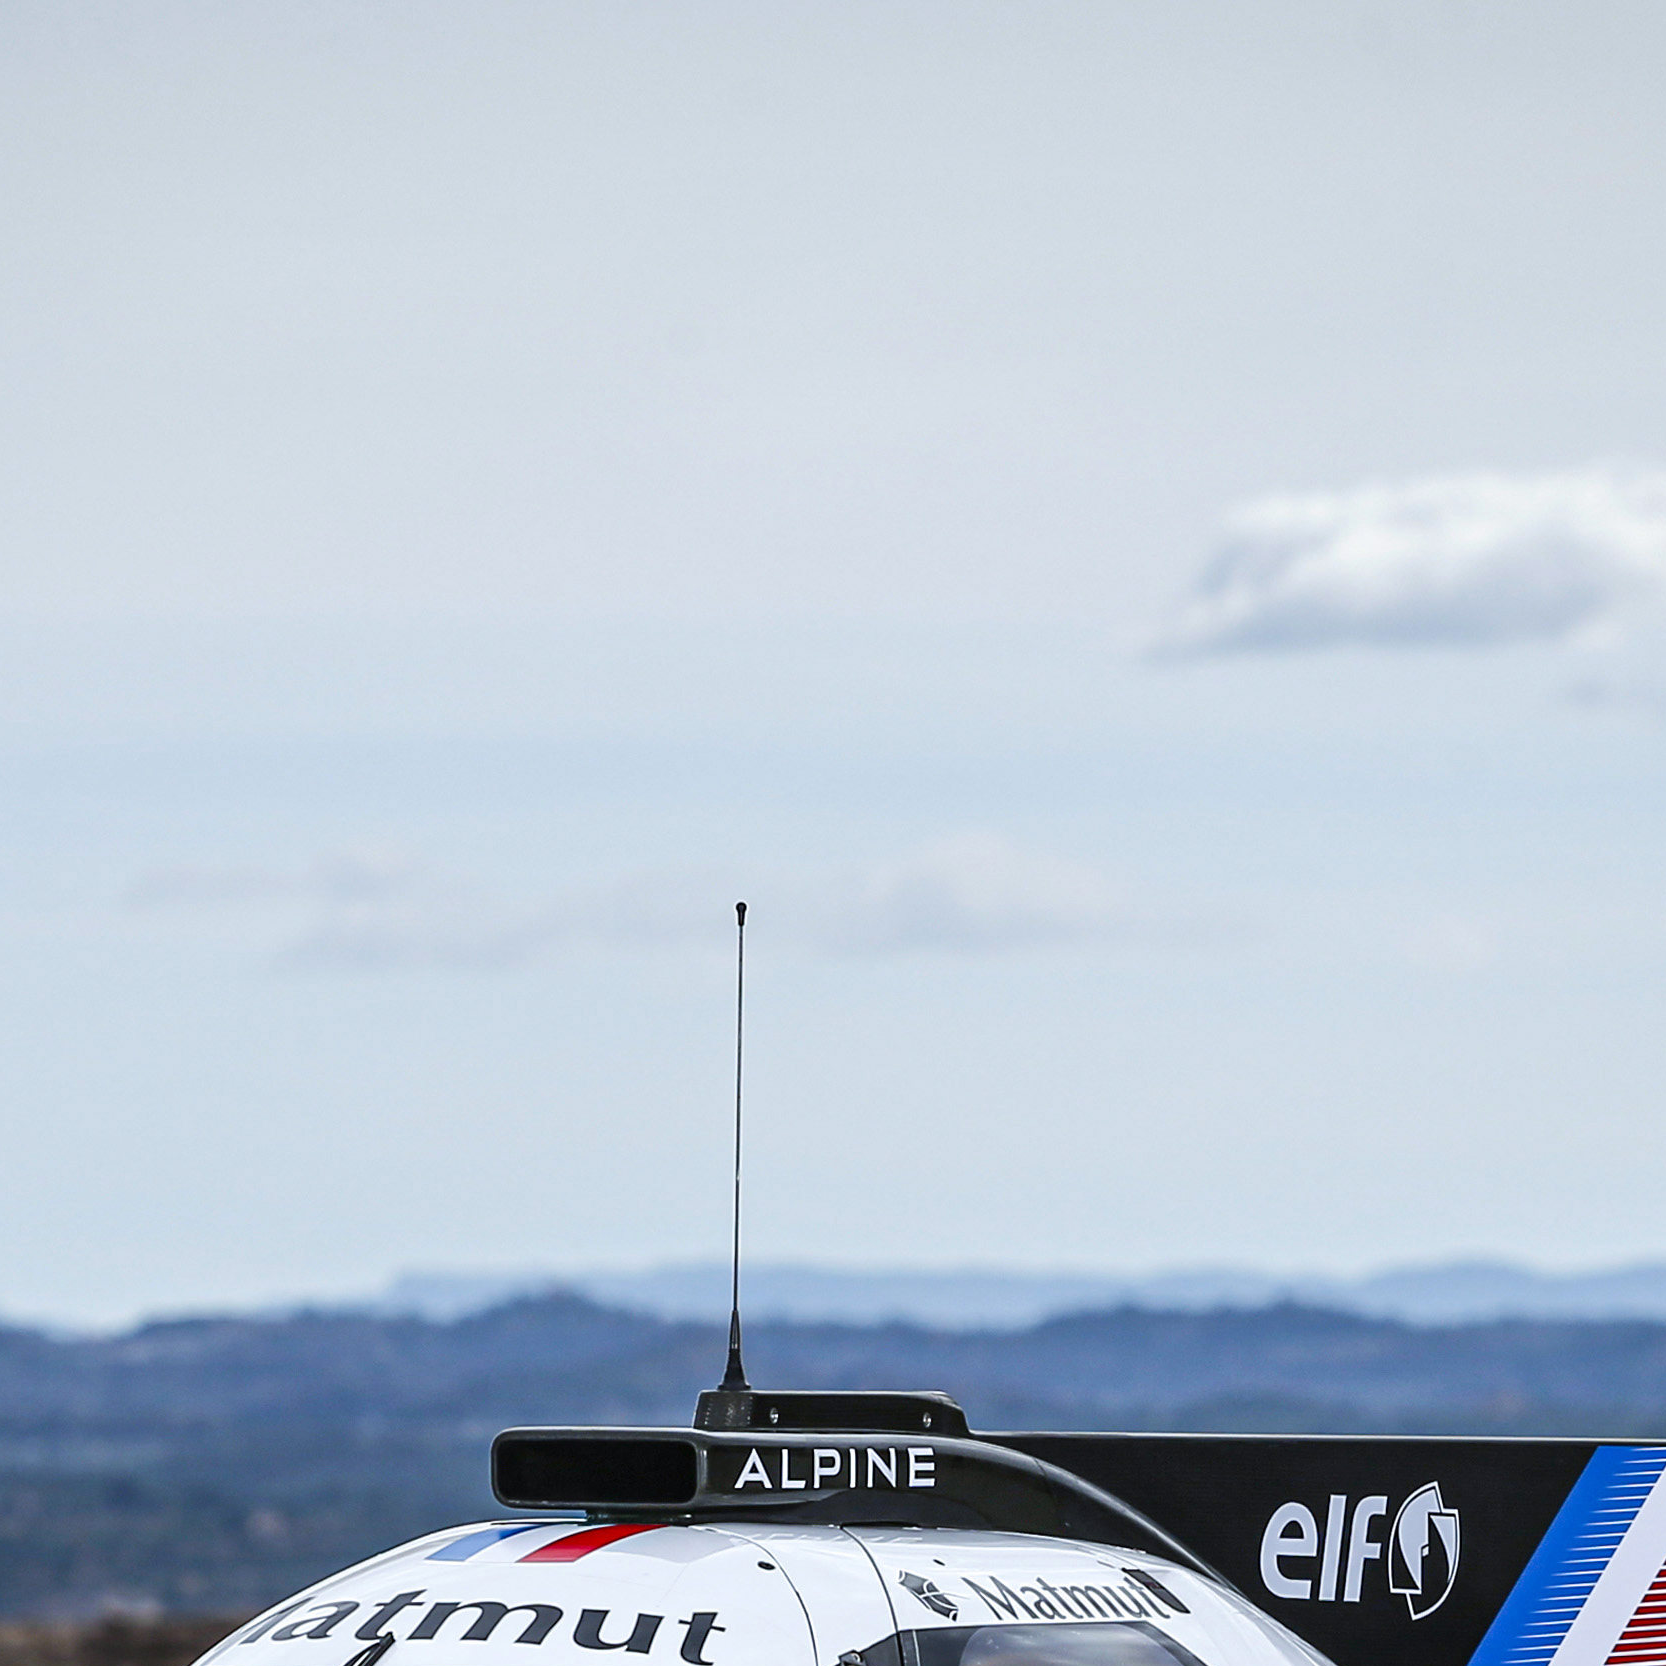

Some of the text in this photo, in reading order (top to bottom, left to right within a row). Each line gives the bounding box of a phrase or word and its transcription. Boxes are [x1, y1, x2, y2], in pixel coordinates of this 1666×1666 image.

[734, 1447, 936, 1490] ALPINE
[1260, 1494, 1388, 1602] elf
[960, 1575, 1172, 1621] Matmut
